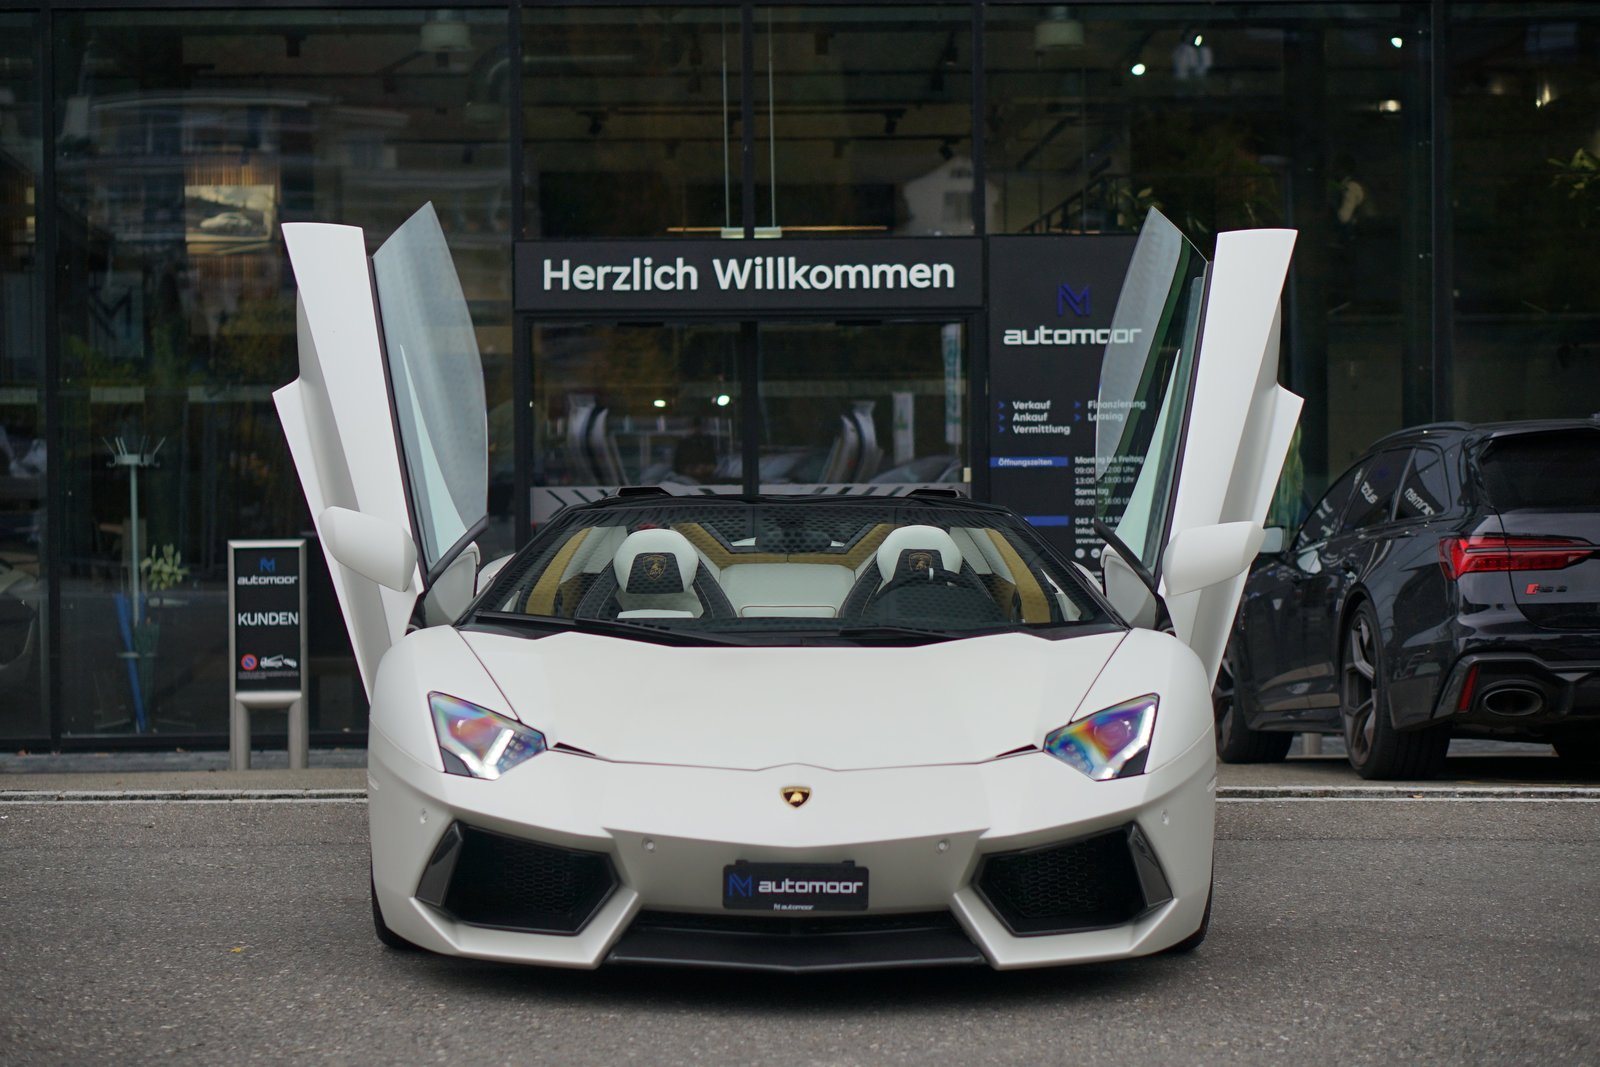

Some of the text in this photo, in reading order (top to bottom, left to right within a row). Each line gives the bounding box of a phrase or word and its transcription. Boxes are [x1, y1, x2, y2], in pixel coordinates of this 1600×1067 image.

[543, 256, 955, 291] Herzlich Willkommen
[1003, 325, 1142, 345] automoor
[1013, 401, 1051, 410] Verkauf
[1013, 412, 1048, 422] Ankauf
[1088, 412, 1123, 422] Leasing
[1013, 425, 1071, 436] Vermittlung
[998, 457, 1053, 467] Öffnungszeiten
[237, 575, 298, 585] automoor
[238, 611, 299, 626] KUNDEN
[758, 878, 863, 894] automoor
